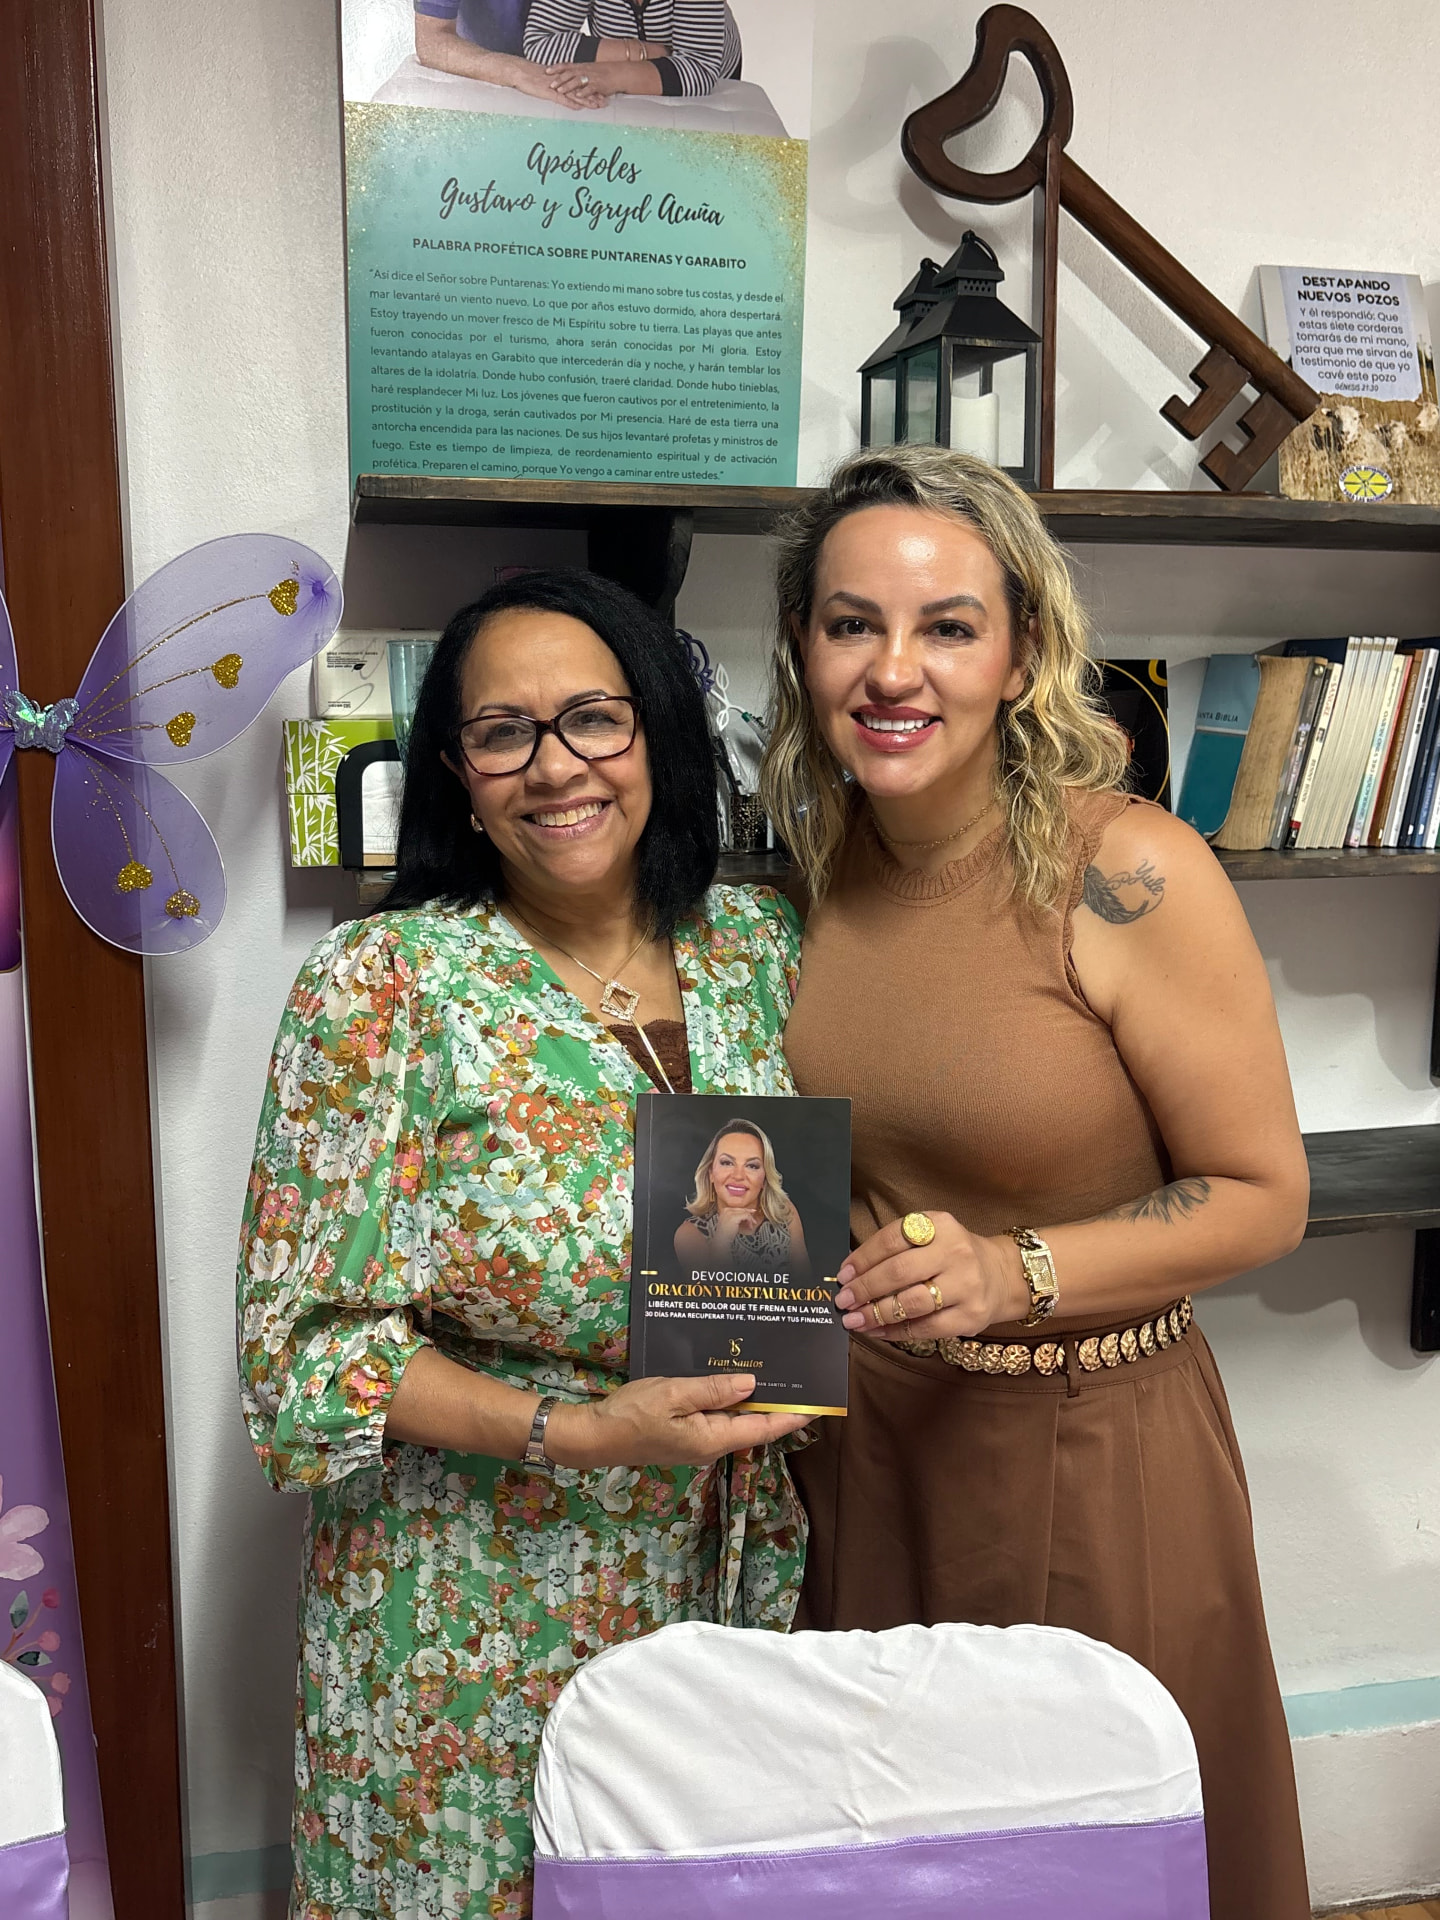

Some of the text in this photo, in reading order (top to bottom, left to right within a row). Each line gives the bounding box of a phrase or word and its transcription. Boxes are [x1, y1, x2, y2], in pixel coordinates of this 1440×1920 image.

[527, 142, 642, 184] Apóstoles
[439, 177, 725, 233] Gustavo y Sigryd Acuña
[413, 238, 747, 270] PALABRA PROFÉTICA SOBRE PUNTARENAS Y GARABITO
[391, 270, 414, 281] dice
[415, 272, 425, 282] el
[427, 272, 457, 284] Señor
[459, 275, 488, 286] sobre
[490, 276, 550, 289] Puntarenas:
[551, 280, 566, 290] Yo
[567, 281, 611, 293] extiendo
[612, 284, 625, 294] mi
[626, 286, 655, 296] mano
[656, 286, 684, 297] sobre
[685, 288, 701, 298] tus
[702, 290, 735, 302] costas,
[736, 293, 743, 303] y
[743, 291, 774, 303] desde
[774, 293, 784, 303] el
[1302, 276, 1390, 292] DESTAPANDO
[1297, 290, 1400, 306] NUEVOS POZOS
[1300, 307, 1399, 323] Y él respondió: Que
[370, 307, 782, 340] Estoy trayendo un mover fresco de Mi Espíritu sobre tu tierra. Las playas que antes
[1299, 320, 1404, 334] estas siete corderas
[1296, 332, 1409, 348] tomarás de mi mano,
[1295, 345, 1413, 359] para que me sirvan de
[370, 346, 781, 376] levantando atalayas en Garabito que intercederán día y noche, y harán temblar los
[1300, 356, 1410, 373] testimonio de que yo
[1318, 370, 1397, 384] cavé este pozo
[371, 383, 780, 412] haré resplandecer Mi luz. Los jóvenes que fueron cautivos por el entretenimiento, la
[372, 422, 778, 447] antorcha encendida para las naciones. De sus hijos levantaré profetas y ministros de
[1322, 681, 1337, 717] SANGRE
[1197, 712, 1213, 720] ANTA
[692, 1270, 790, 1284] DEVOCIONAL DE
[648, 1282, 832, 1302] ORACIÓN Y RESTAURACIÓN
[648, 1300, 831, 1314] LIBÉRATE DEL DOLOR QUE TE FRENA EN LA VIDA.
[687, 1312, 725, 1320] RECUPERAR
[800, 1316, 834, 1324] FINANZAS.
[708, 1357, 764, 1368] Fran Santos
